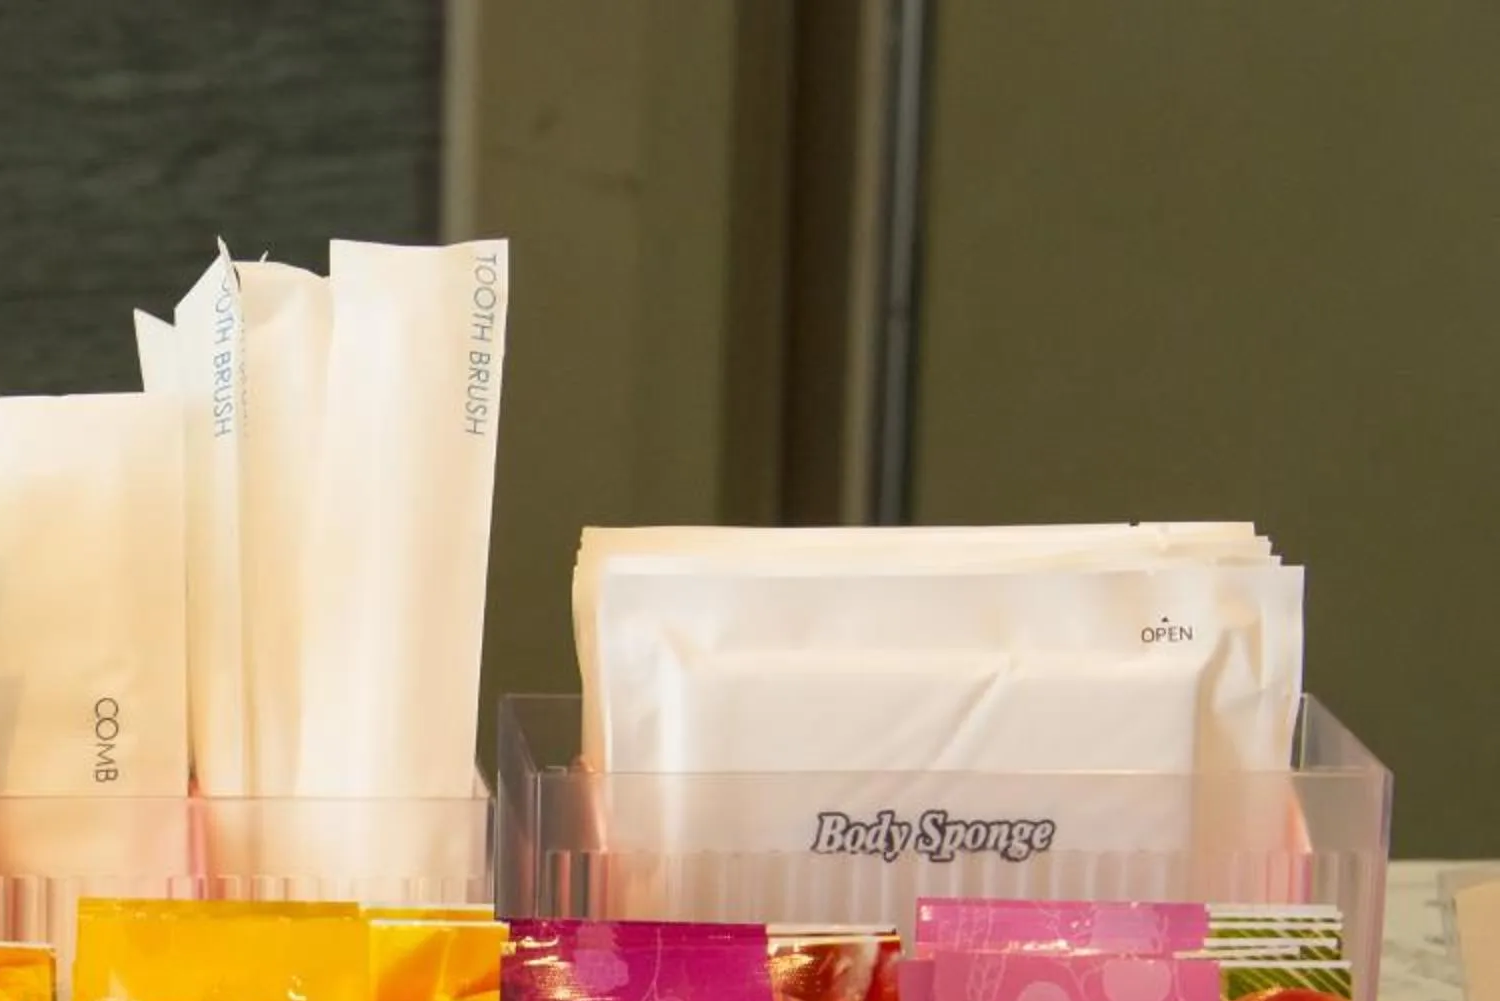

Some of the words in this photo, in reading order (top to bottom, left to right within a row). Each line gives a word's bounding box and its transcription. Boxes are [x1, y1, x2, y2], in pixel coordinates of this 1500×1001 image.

[471, 253, 498, 342] TOOTH
[213, 351, 234, 438] BRUSH
[464, 350, 491, 436] BRUSH
[1141, 626, 1194, 643] OPEN
[94, 697, 119, 783] COMB
[811, 810, 910, 861] Body
[915, 809, 1056, 862] Sponge
